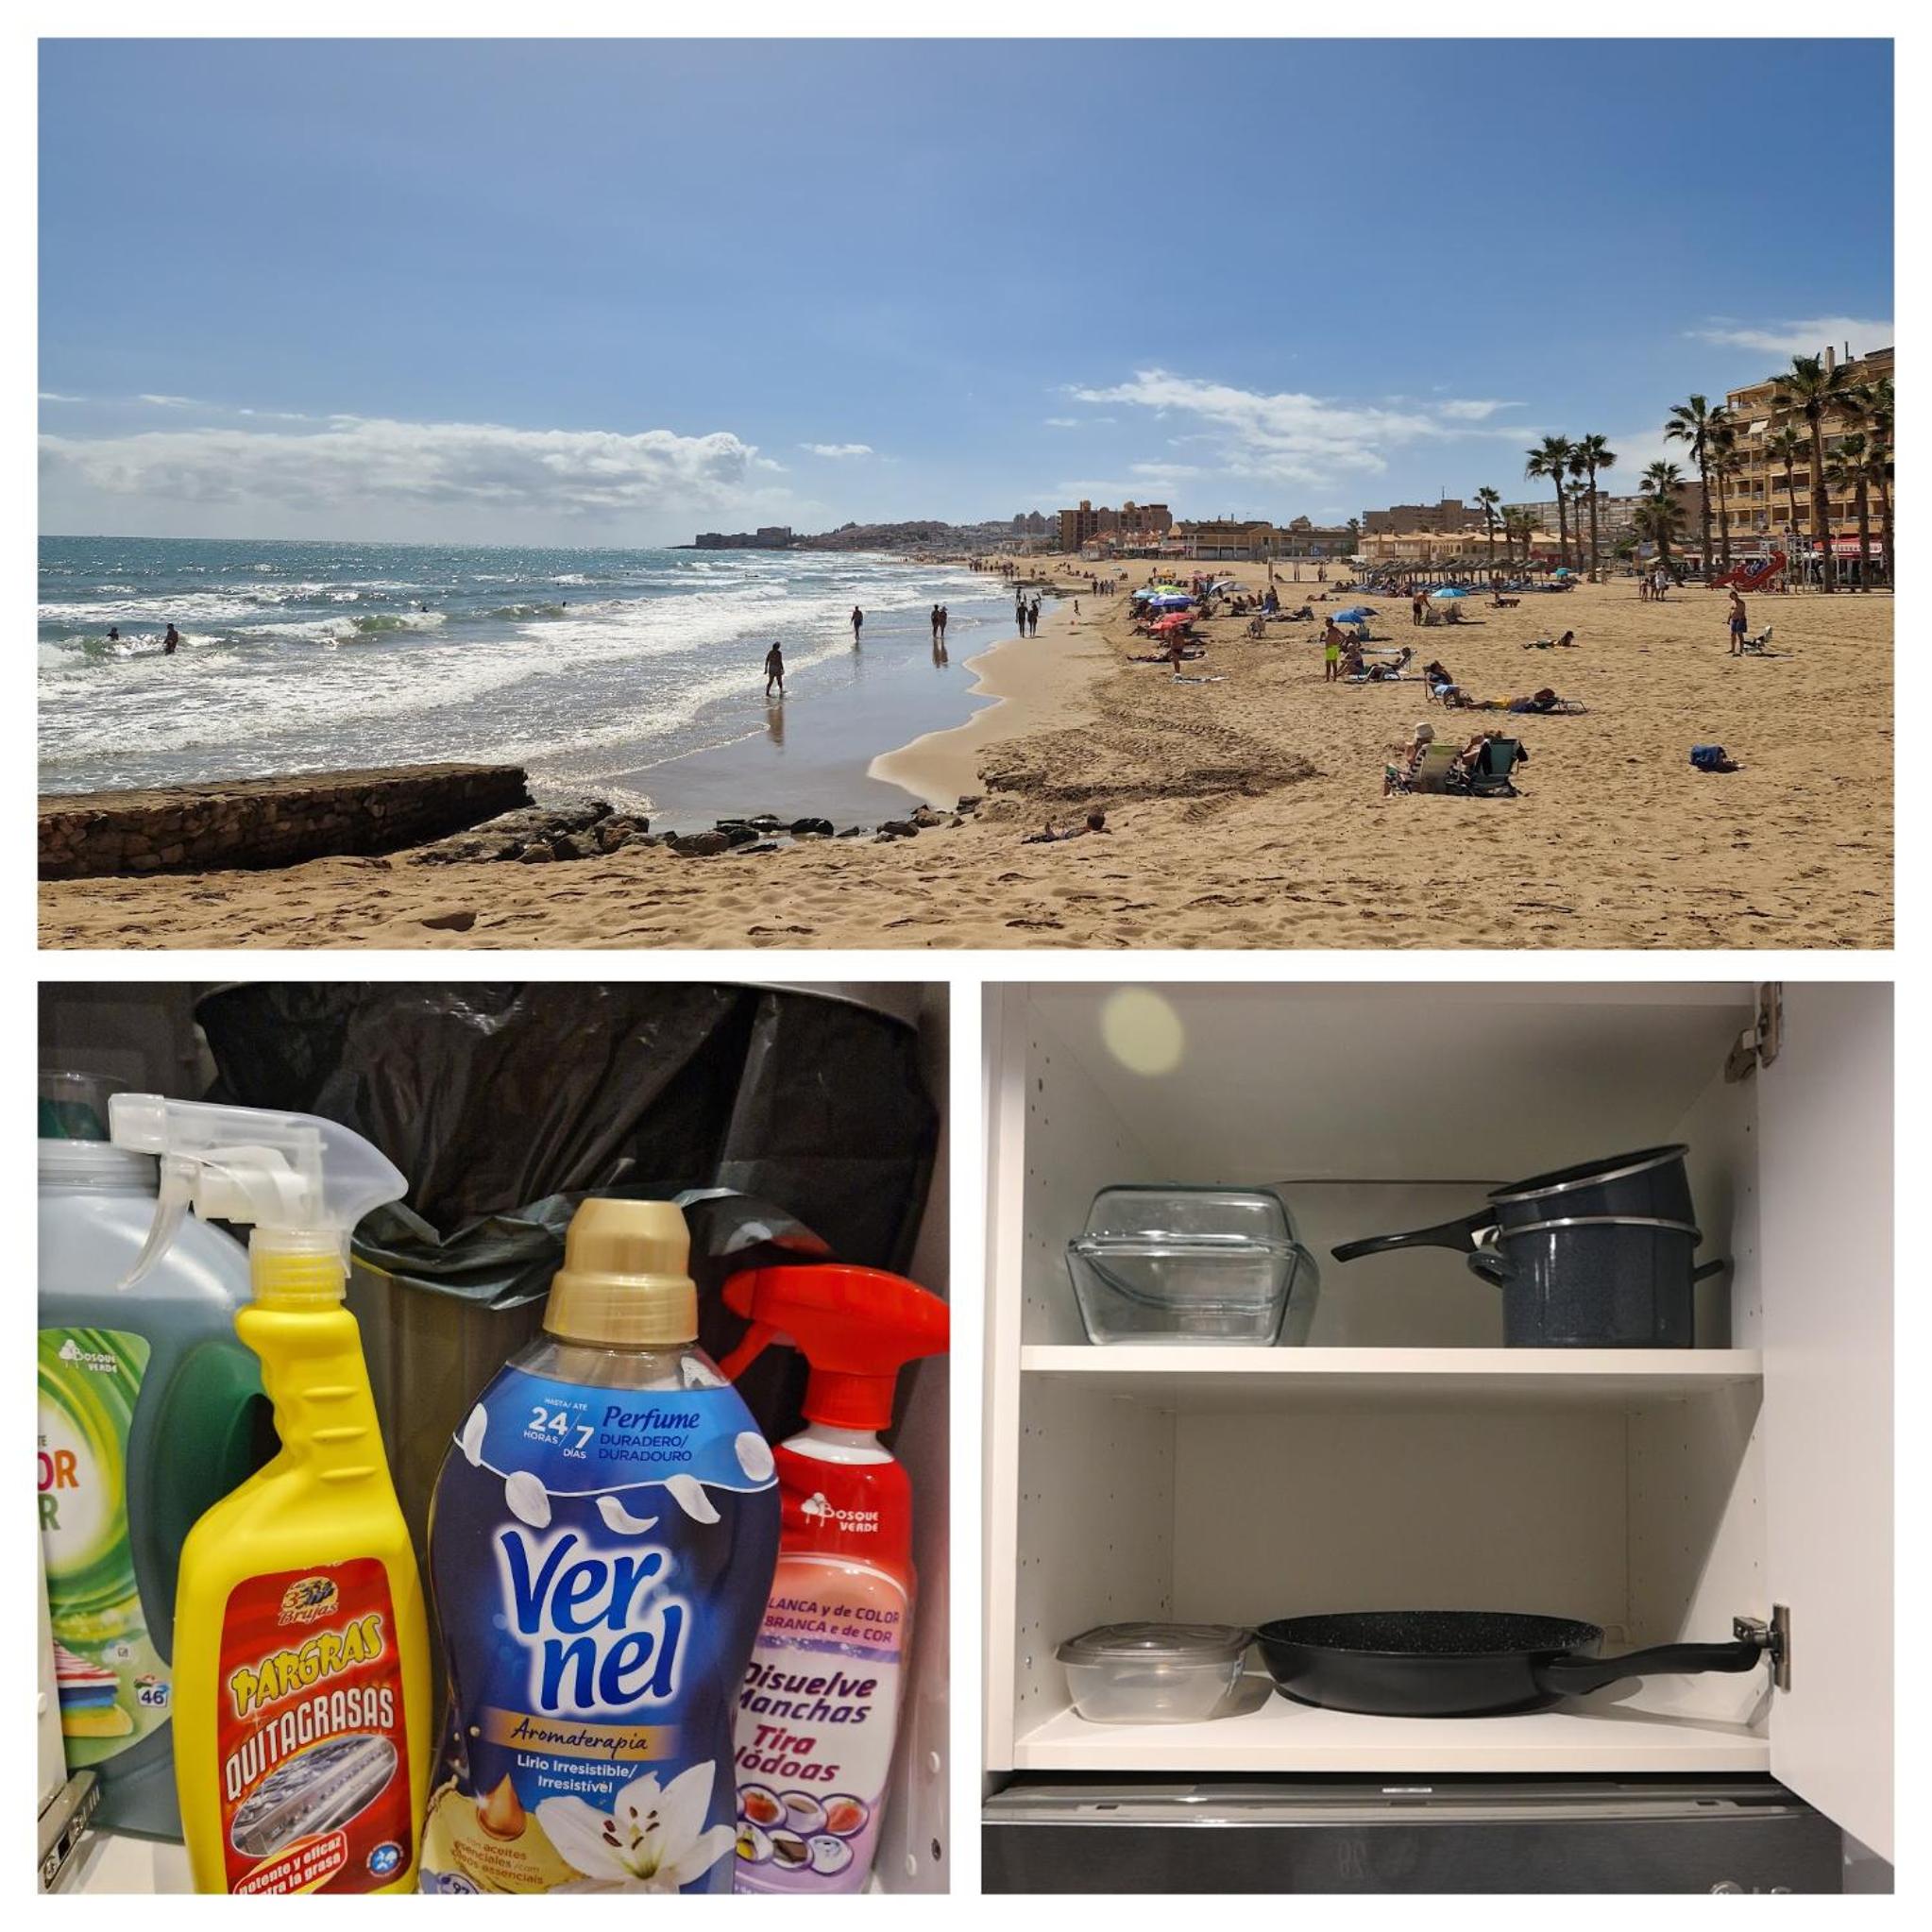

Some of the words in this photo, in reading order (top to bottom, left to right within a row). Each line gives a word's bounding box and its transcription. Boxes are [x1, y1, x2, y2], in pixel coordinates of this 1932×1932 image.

[88, 1363, 117, 1373] VERDE
[602, 1405, 701, 1432] Perfume
[523, 1430, 559, 1445] HORAS
[600, 1433, 689, 1449] DURADERO/
[563, 1448, 587, 1459] DÍAS
[598, 1449, 693, 1463] DURADOURO
[839, 1521, 879, 1533] VERDE
[500, 1530, 663, 1635] Ver
[768, 1598, 818, 1614] LANCA
[821, 1606, 831, 1618] y
[833, 1605, 852, 1618] de
[855, 1608, 900, 1624] COLOR
[763, 1615, 827, 1633] BRANCA
[830, 1626, 839, 1635] e
[841, 1625, 861, 1638] de
[862, 1629, 893, 1643] COR
[232, 1616, 382, 1717] PARGRAS
[540, 1604, 683, 1711] nel
[744, 1662, 877, 1698] Disuelve
[141, 1690, 164, 1704] 46
[225, 1687, 394, 1802] QUITAGRASAS
[510, 1718, 649, 1759] Aromaterapia
[754, 1723, 817, 1754] Tira
[517, 1754, 550, 1771] Lirio
[552, 1760, 638, 1779] Irresistible/
[293, 1856, 301, 1871] y
[303, 1835, 342, 1864] eficaz
[288, 1873, 302, 1888] la
[304, 1852, 342, 1881] grasa
